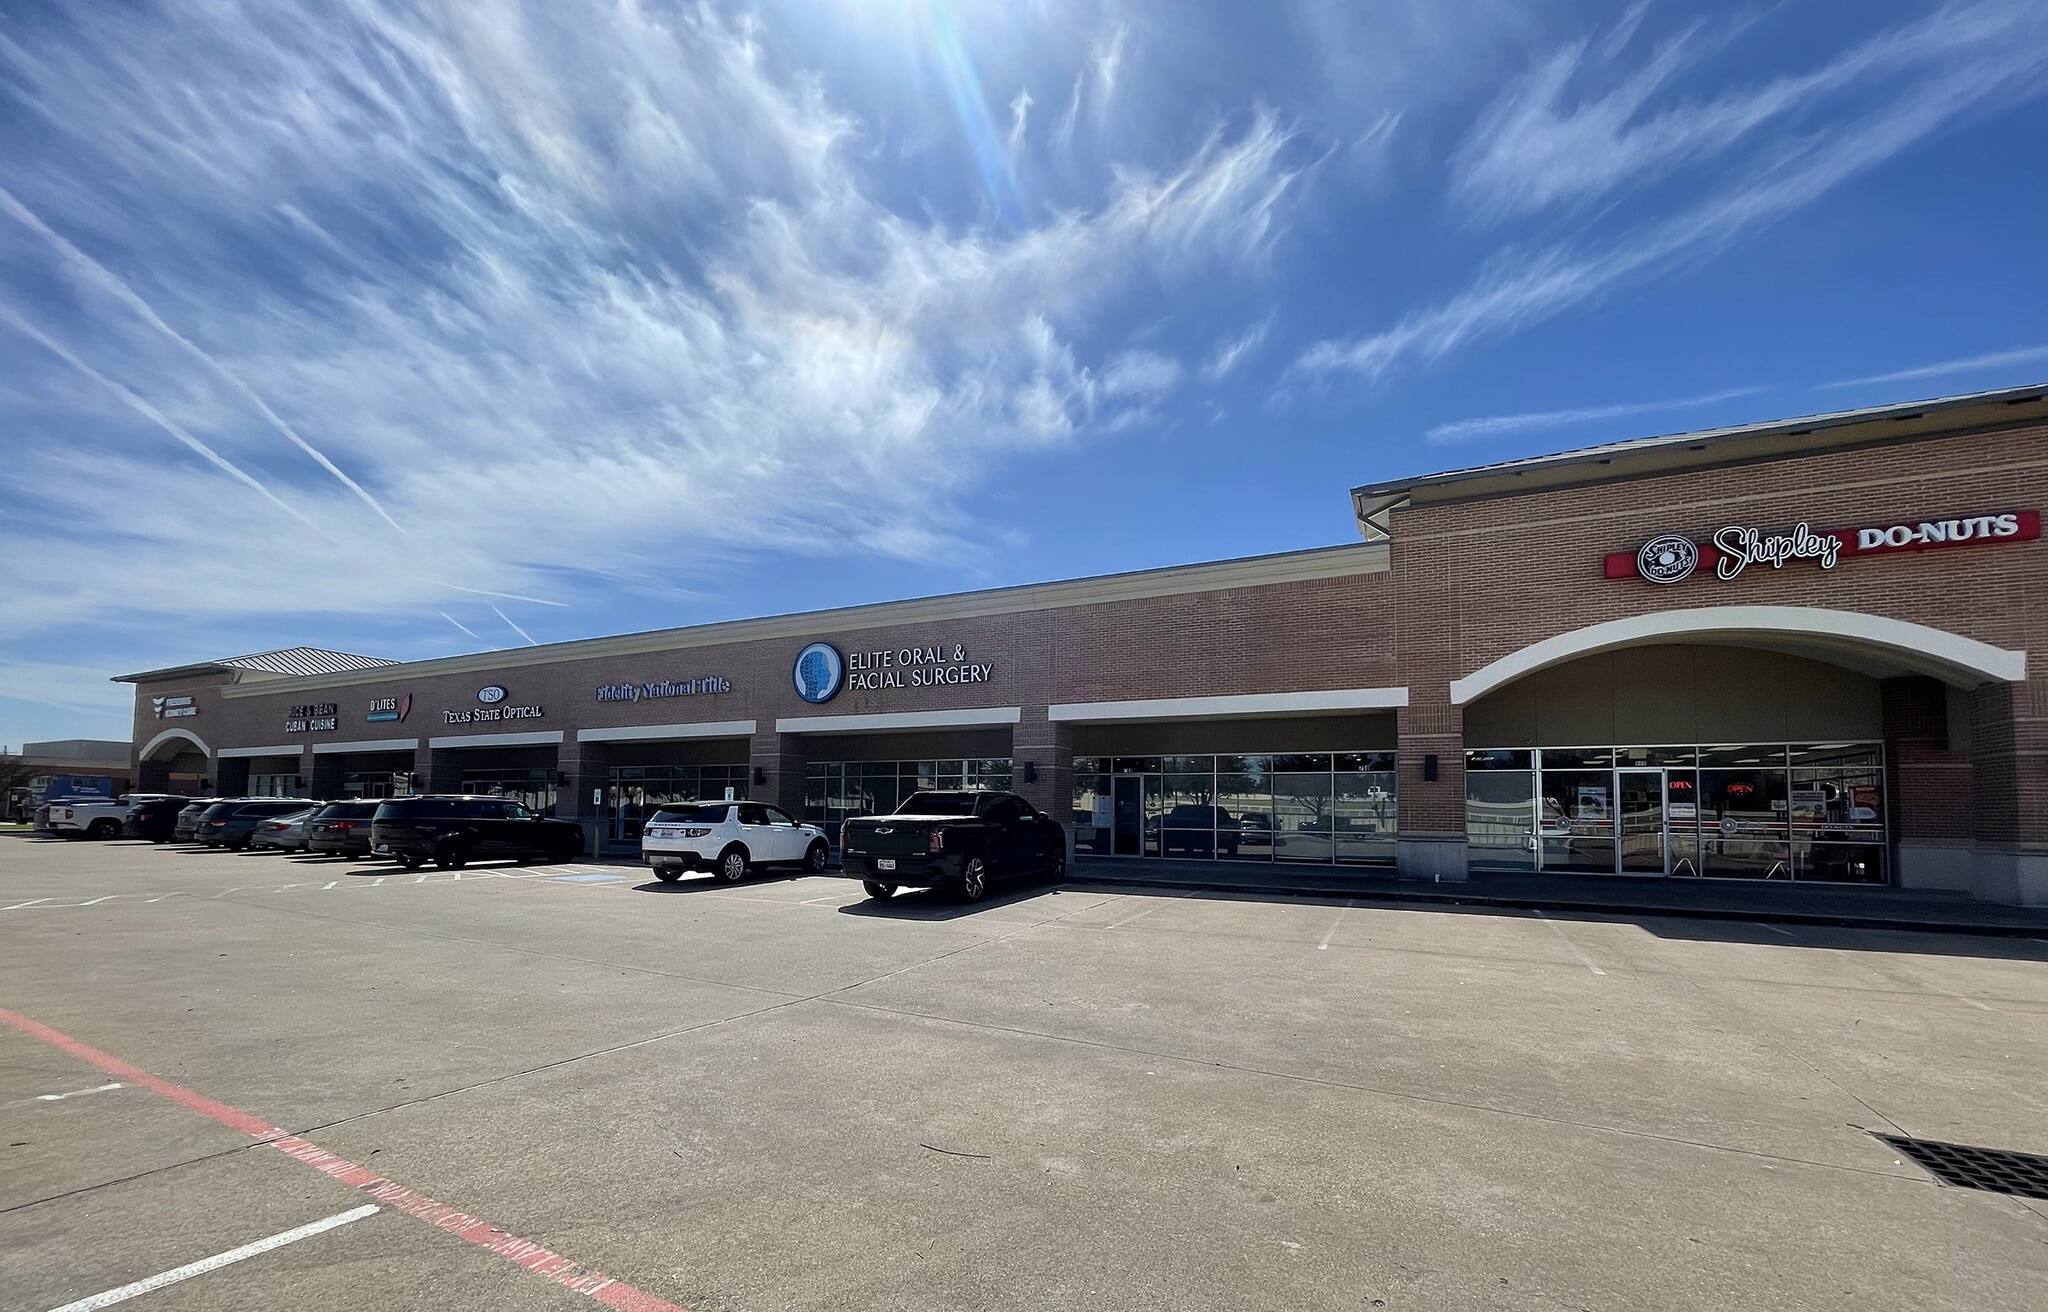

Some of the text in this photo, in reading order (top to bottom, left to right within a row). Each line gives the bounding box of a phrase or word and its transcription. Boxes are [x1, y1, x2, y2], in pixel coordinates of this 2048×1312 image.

[1645, 542, 1688, 560] SHIPLEY
[1713, 514, 2019, 581] Shipley DO-NUTS
[1650, 557, 1692, 576] DO-NUTS
[849, 643, 965, 670] ELITE ORAL &
[849, 664, 993, 690] FACIAL SURGERY
[483, 688, 500, 701] TSO
[596, 676, 731, 703] Fidelity National Title
[314, 703, 334, 716] BEAN
[443, 705, 542, 723] TEXAS STATE OPTICAL
[285, 718, 335, 732] CUBAN CUISINE
[1669, 780, 1692, 789] OPEN
[1727, 784, 1754, 793] OPEN
